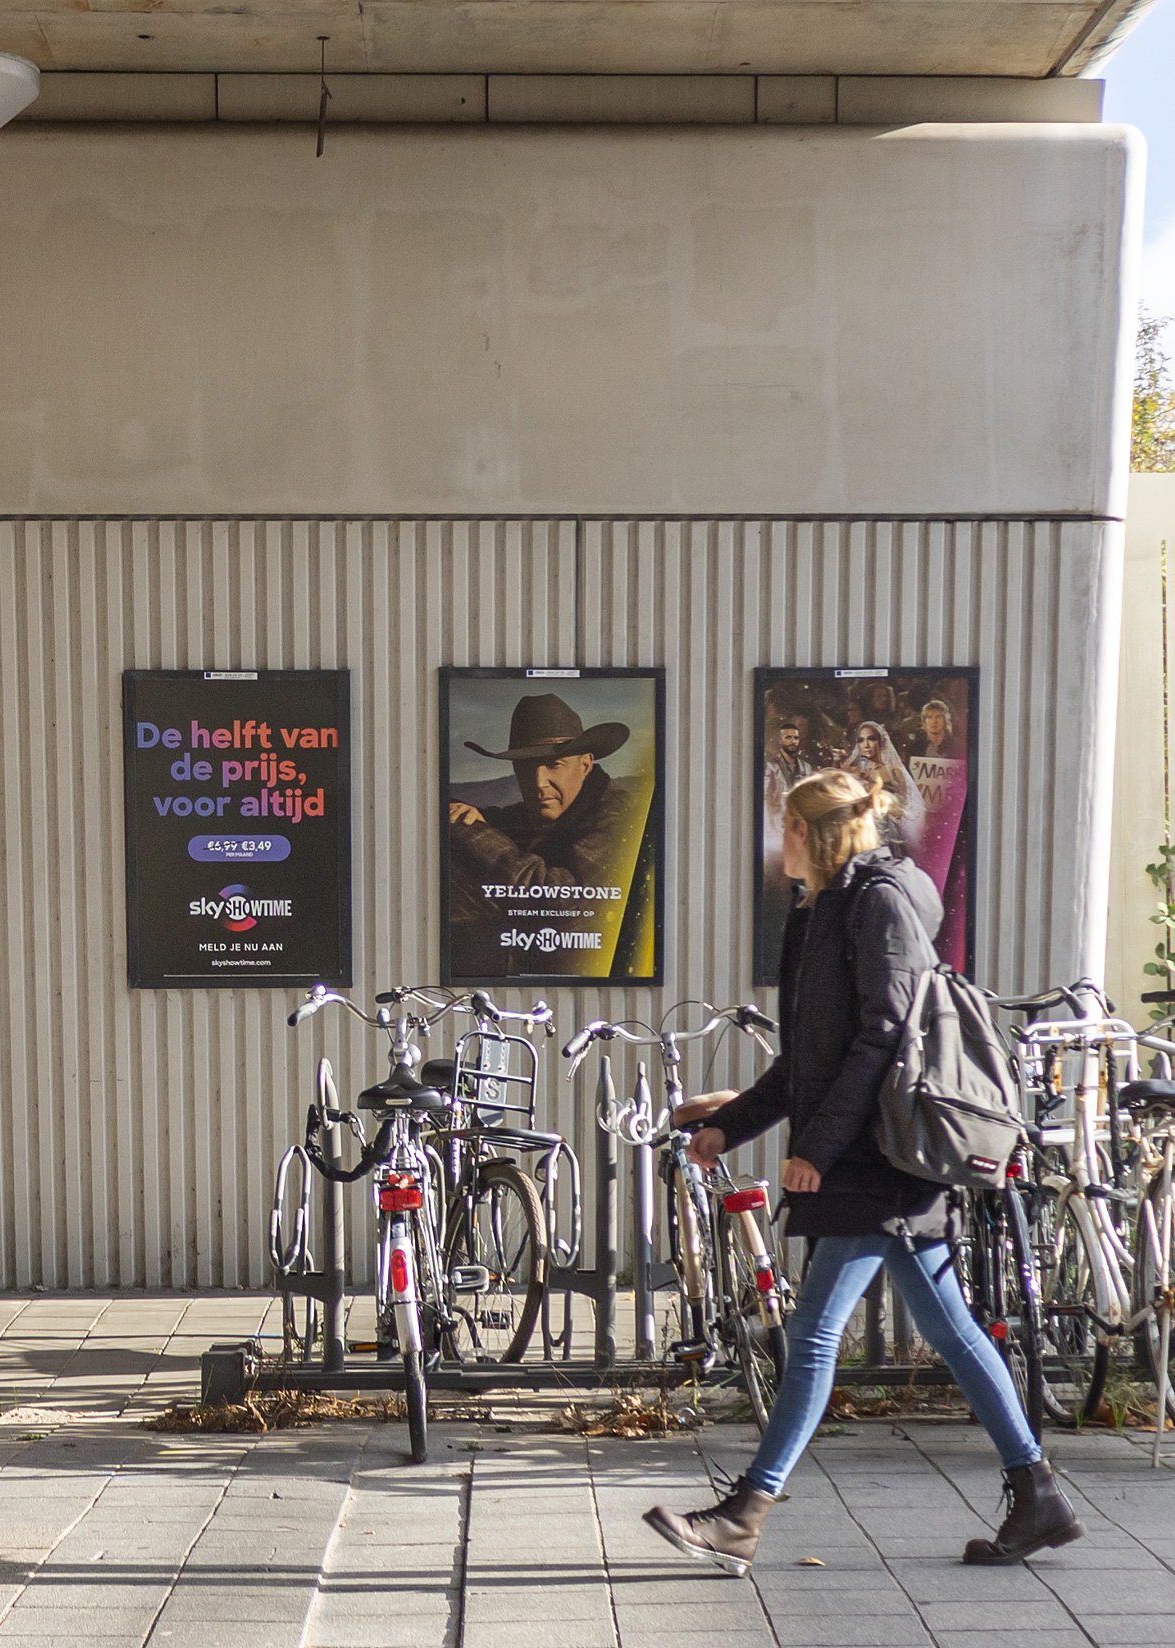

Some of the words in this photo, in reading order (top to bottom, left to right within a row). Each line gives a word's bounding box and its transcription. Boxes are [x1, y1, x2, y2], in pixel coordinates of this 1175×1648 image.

[137, 721, 183, 749] De
[191, 720, 273, 749] helft
[280, 727, 339, 749] van
[170, 752, 213, 781] de
[222, 752, 307, 788] prijs,
[152, 796, 231, 817] voor
[240, 788, 325, 824] altijd
[241, 840, 272, 852] €3,49
[481, 884, 622, 900] YELLOWSTONE
[507, 909, 539, 917] STREAM
[540, 909, 581, 917] EXCLUSIEF
[198, 943, 227, 952] MELD
[229, 943, 241, 952] JE
[244, 943, 259, 952] NU
[261, 943, 284, 952] AAN
[211, 959, 272, 968] skyshowtime.com
